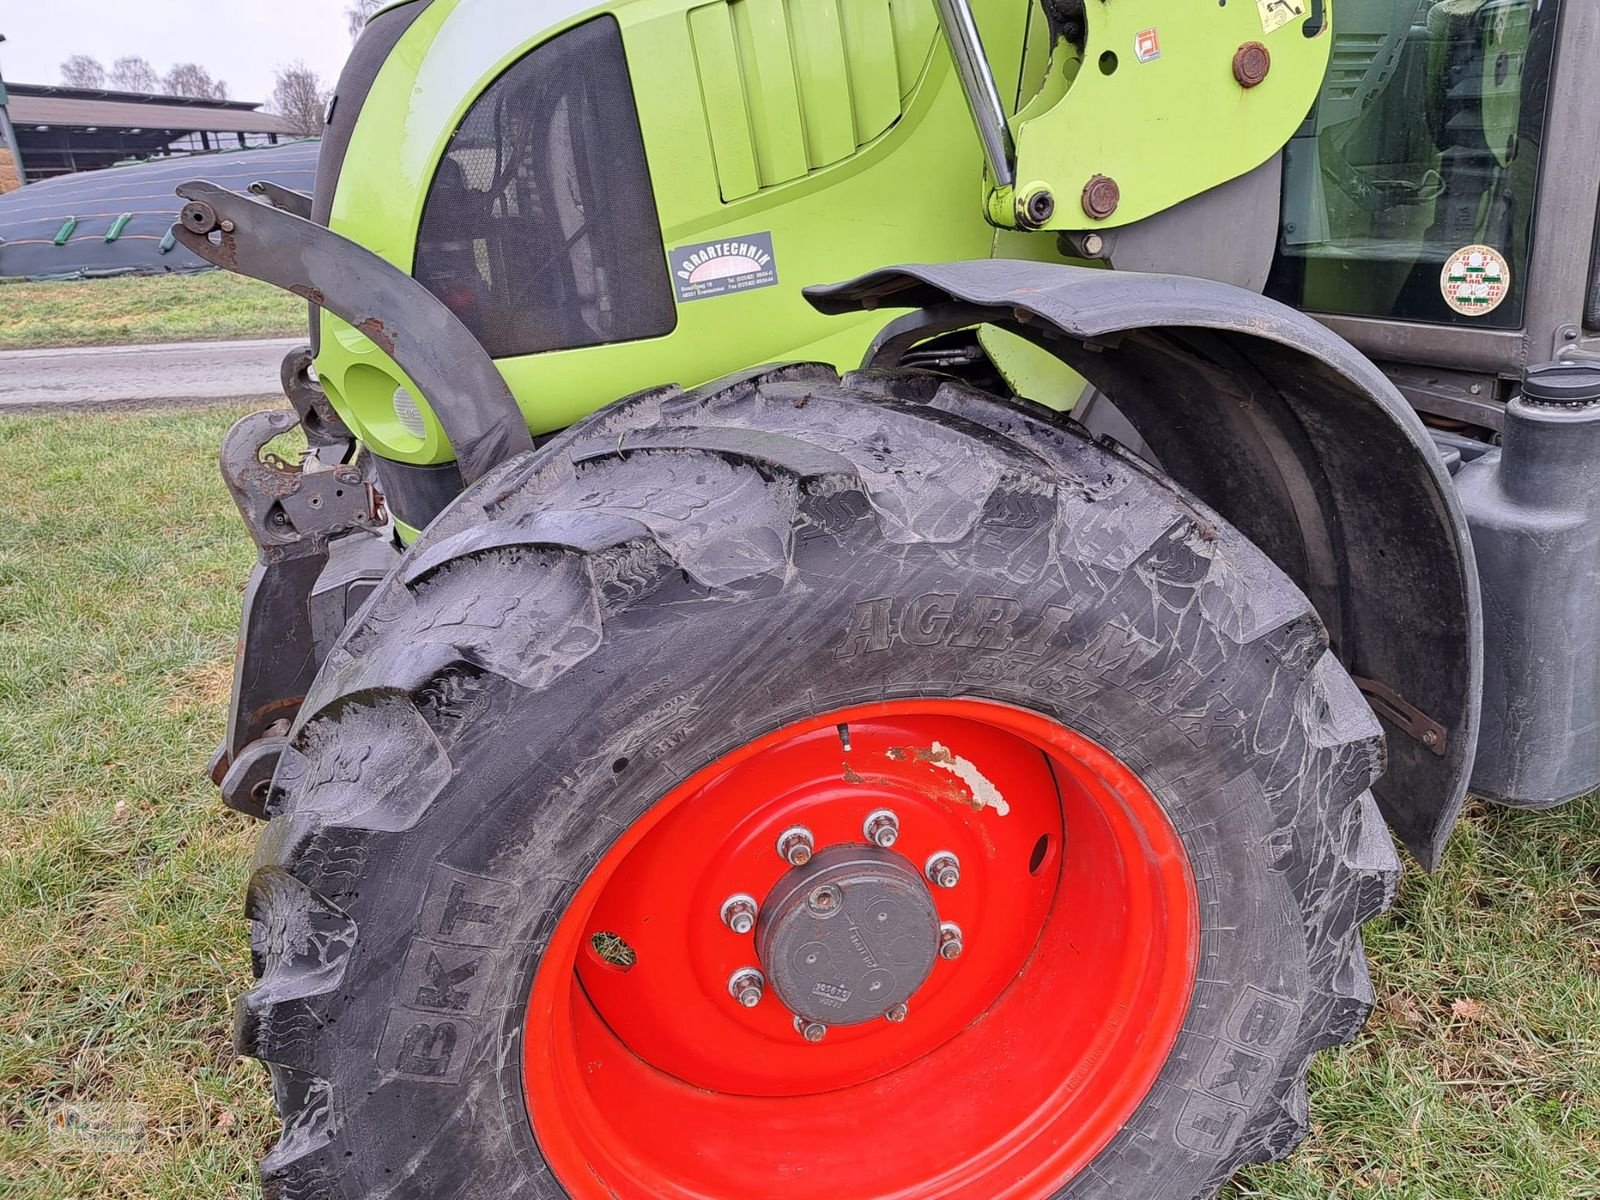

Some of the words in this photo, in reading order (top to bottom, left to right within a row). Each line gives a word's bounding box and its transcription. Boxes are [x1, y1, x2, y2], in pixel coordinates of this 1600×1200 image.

[677, 242, 771, 280] AGRARTECHNIK
[397, 876, 502, 1079] BKT
[1189, 997, 1295, 1150] BKT
